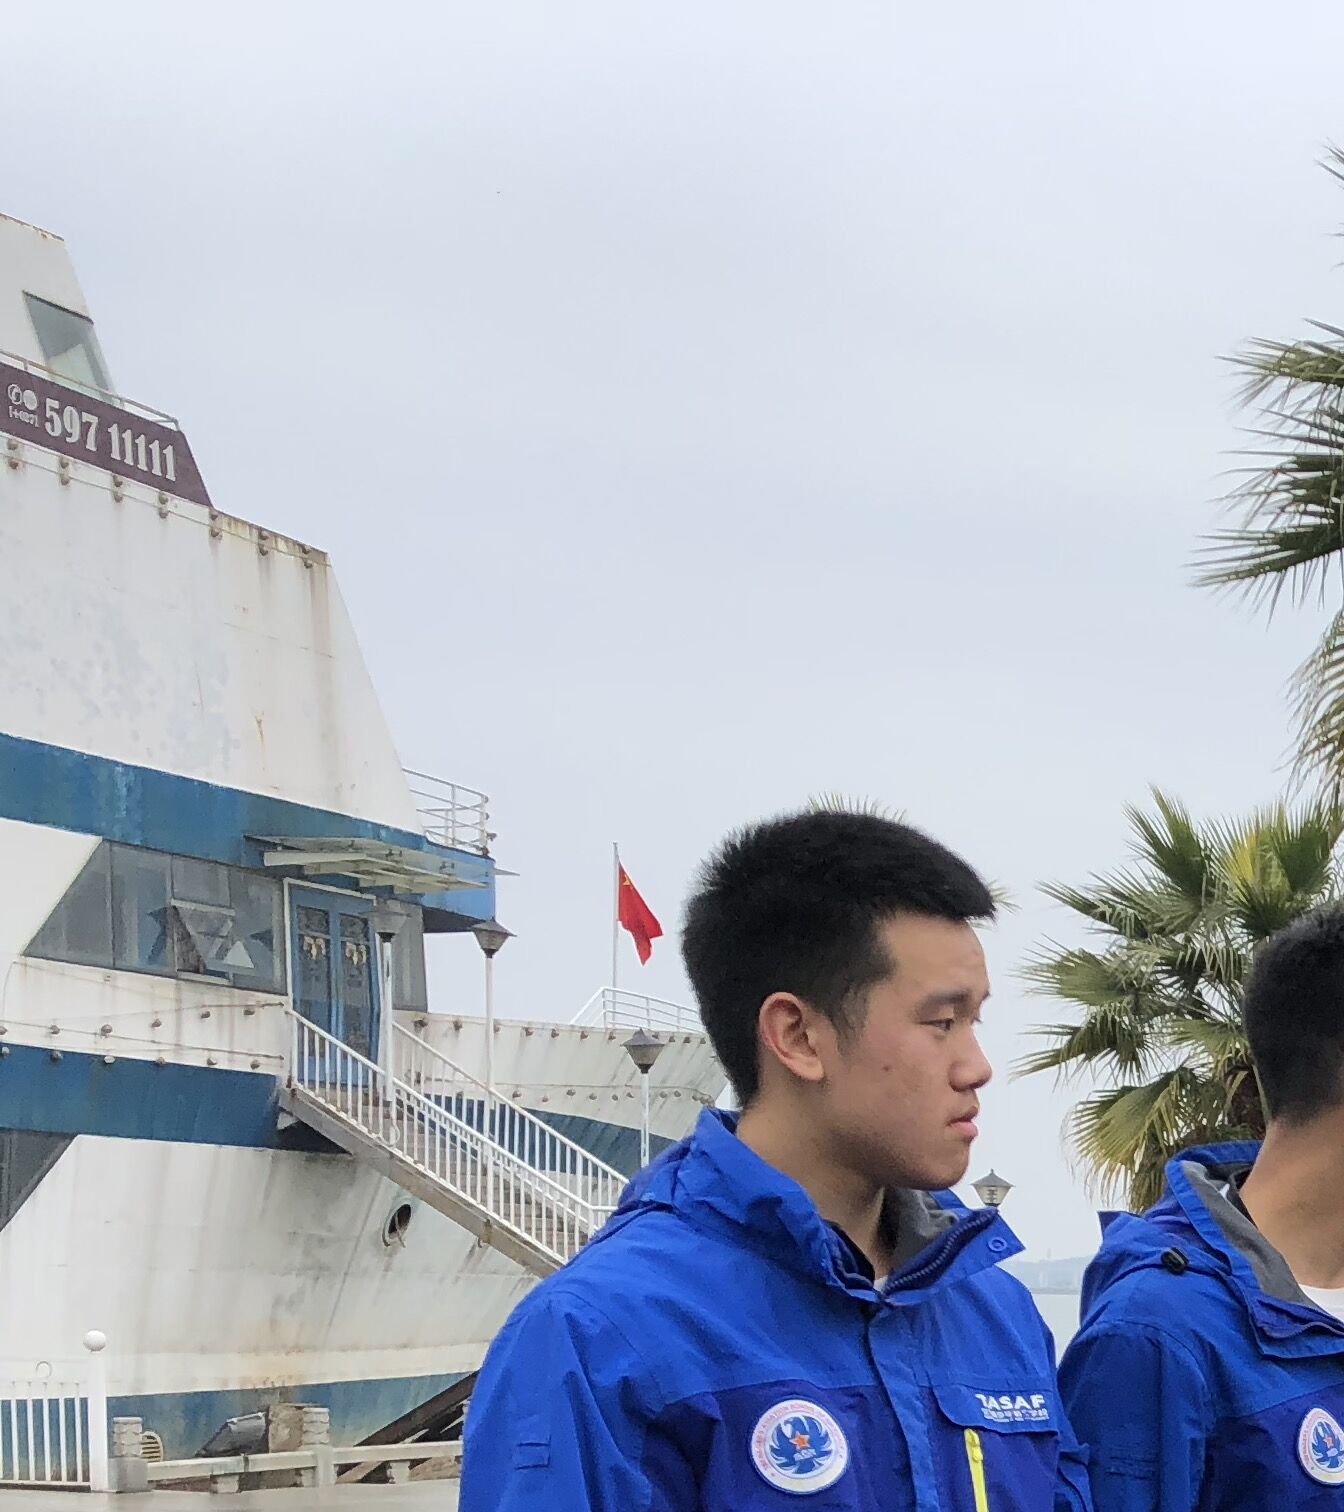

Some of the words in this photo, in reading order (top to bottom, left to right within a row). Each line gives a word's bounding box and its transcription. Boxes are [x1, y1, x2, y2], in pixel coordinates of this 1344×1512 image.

[45, 397, 99, 452] 597
[107, 423, 177, 482] 11111
[974, 1393, 1045, 1411] TASAF
